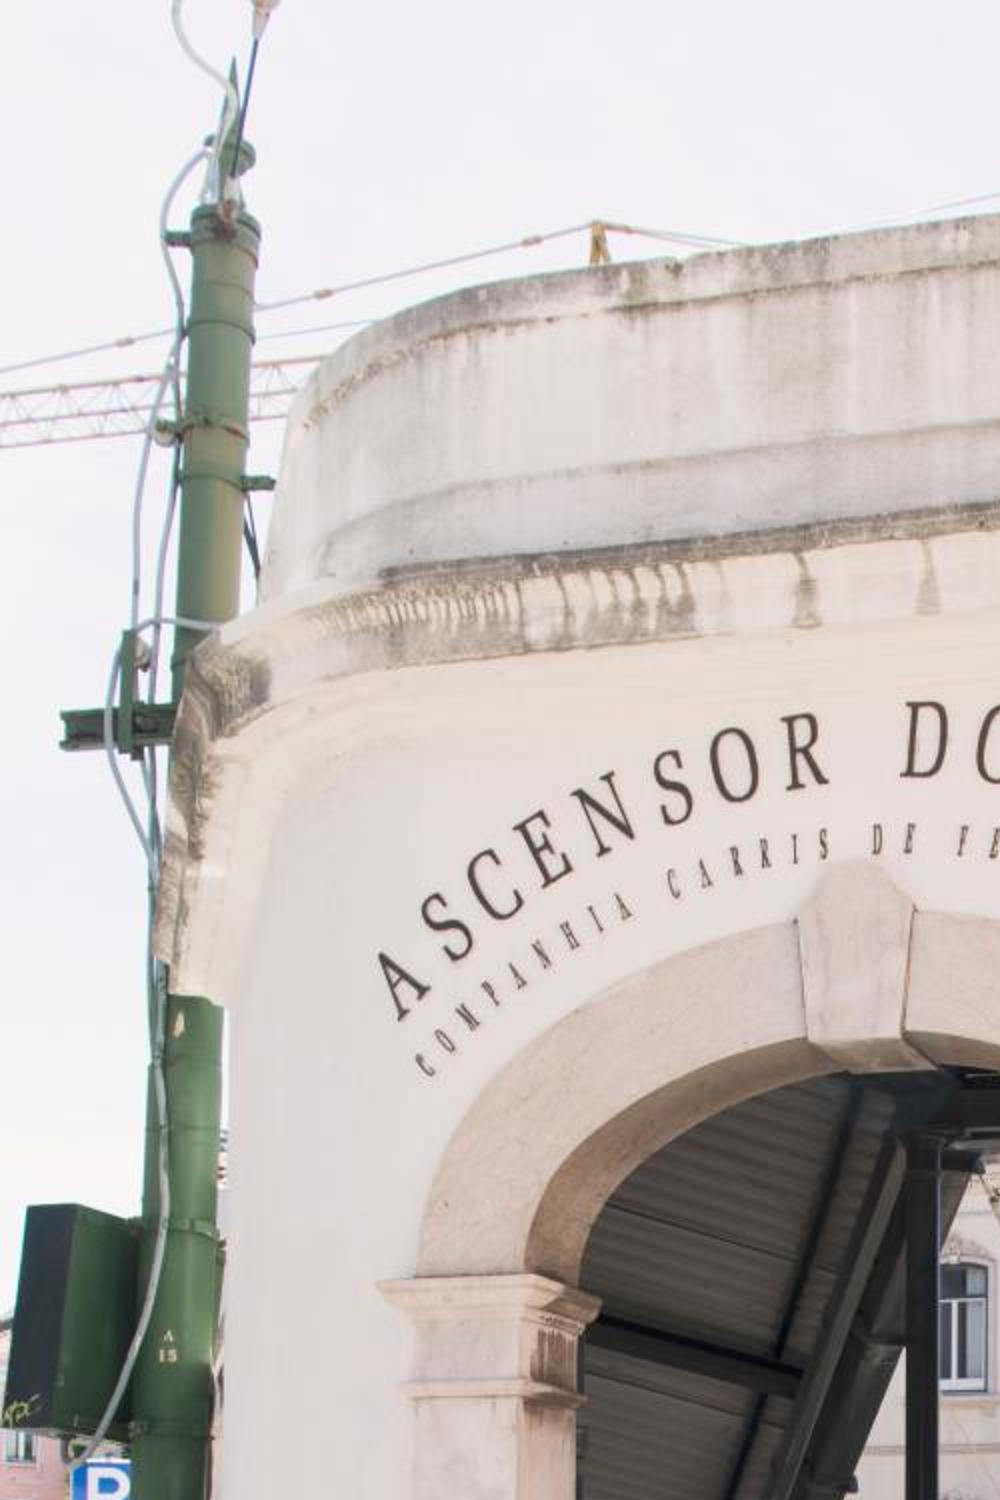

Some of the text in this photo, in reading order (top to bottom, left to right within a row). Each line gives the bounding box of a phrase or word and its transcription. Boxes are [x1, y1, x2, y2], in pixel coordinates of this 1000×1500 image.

[376, 711, 831, 1023] ASCENSOR
[414, 892, 634, 1078] COMPANHIA
[666, 827, 830, 900] CARRIS
[871, 821, 917, 857] DE
